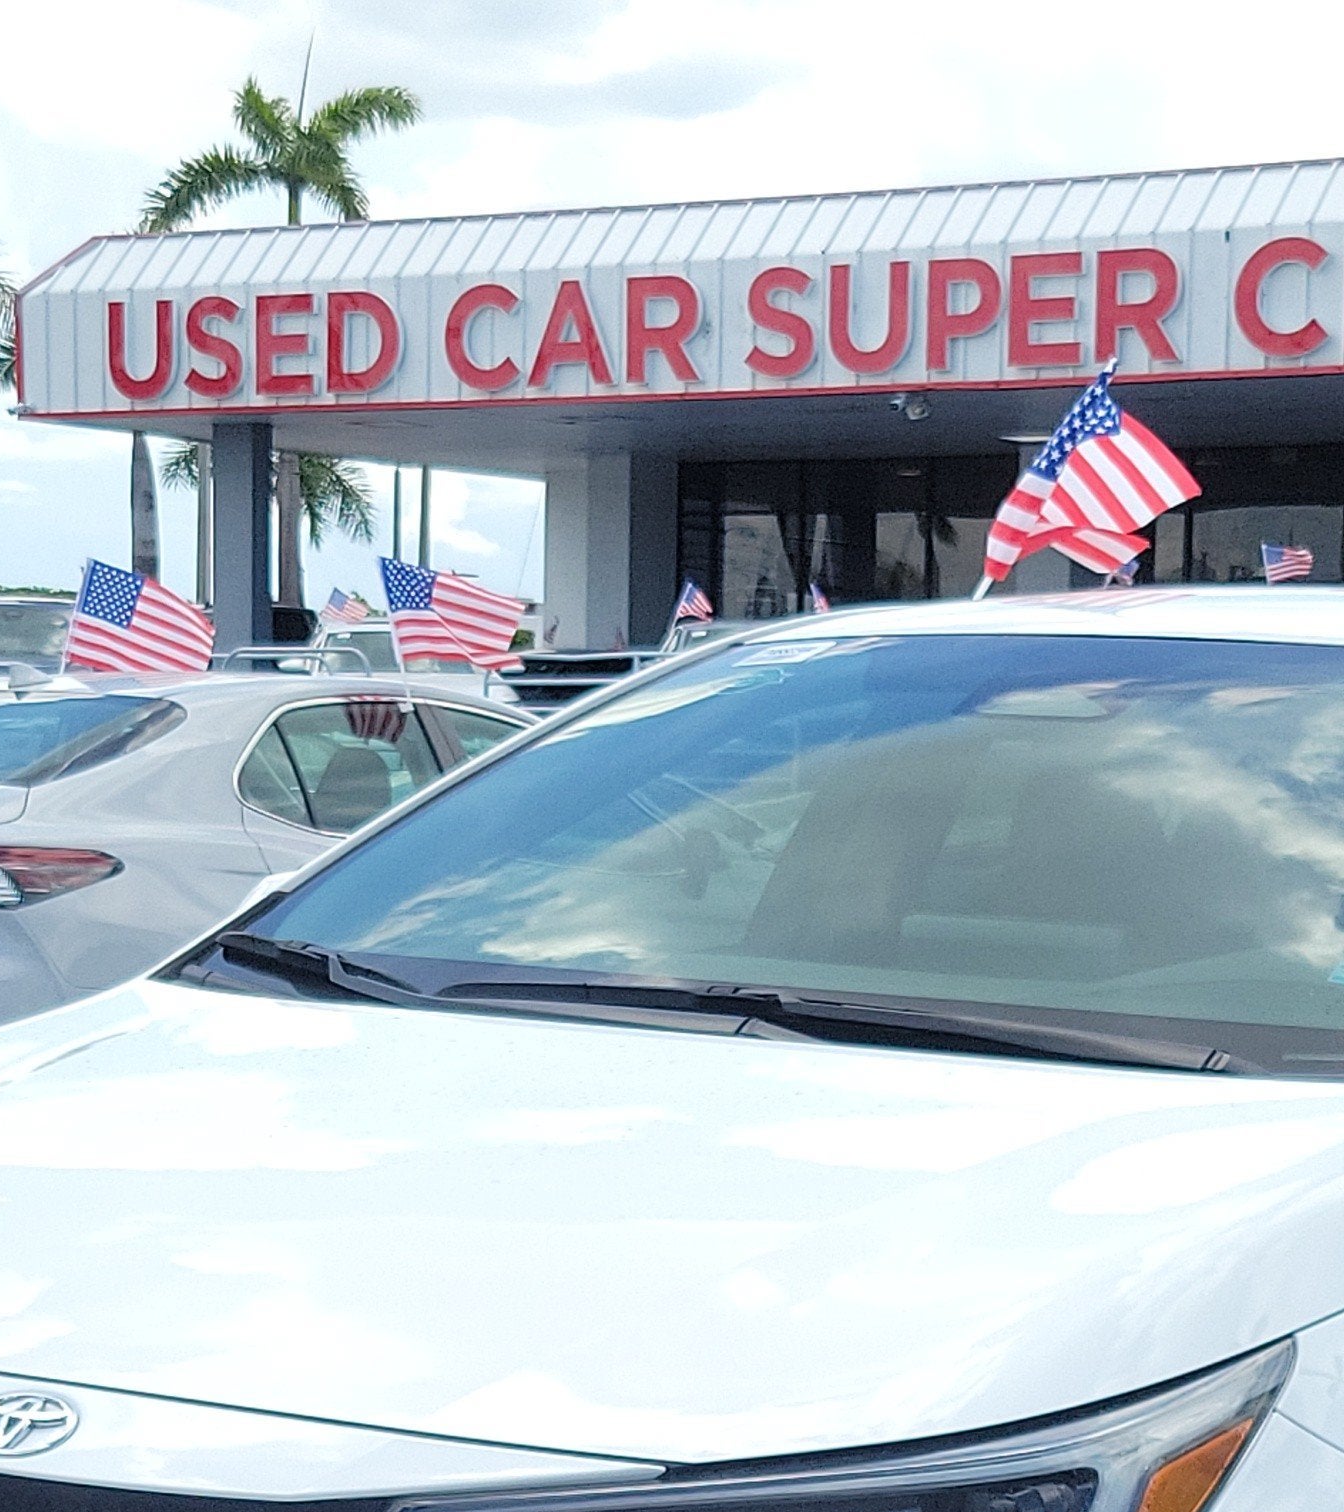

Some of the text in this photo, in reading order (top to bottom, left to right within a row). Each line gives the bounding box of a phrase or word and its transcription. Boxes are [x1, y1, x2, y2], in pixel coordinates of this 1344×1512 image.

[106, 290, 402, 400] USED
[444, 274, 703, 392] CAR
[744, 247, 1182, 378] SUPER
